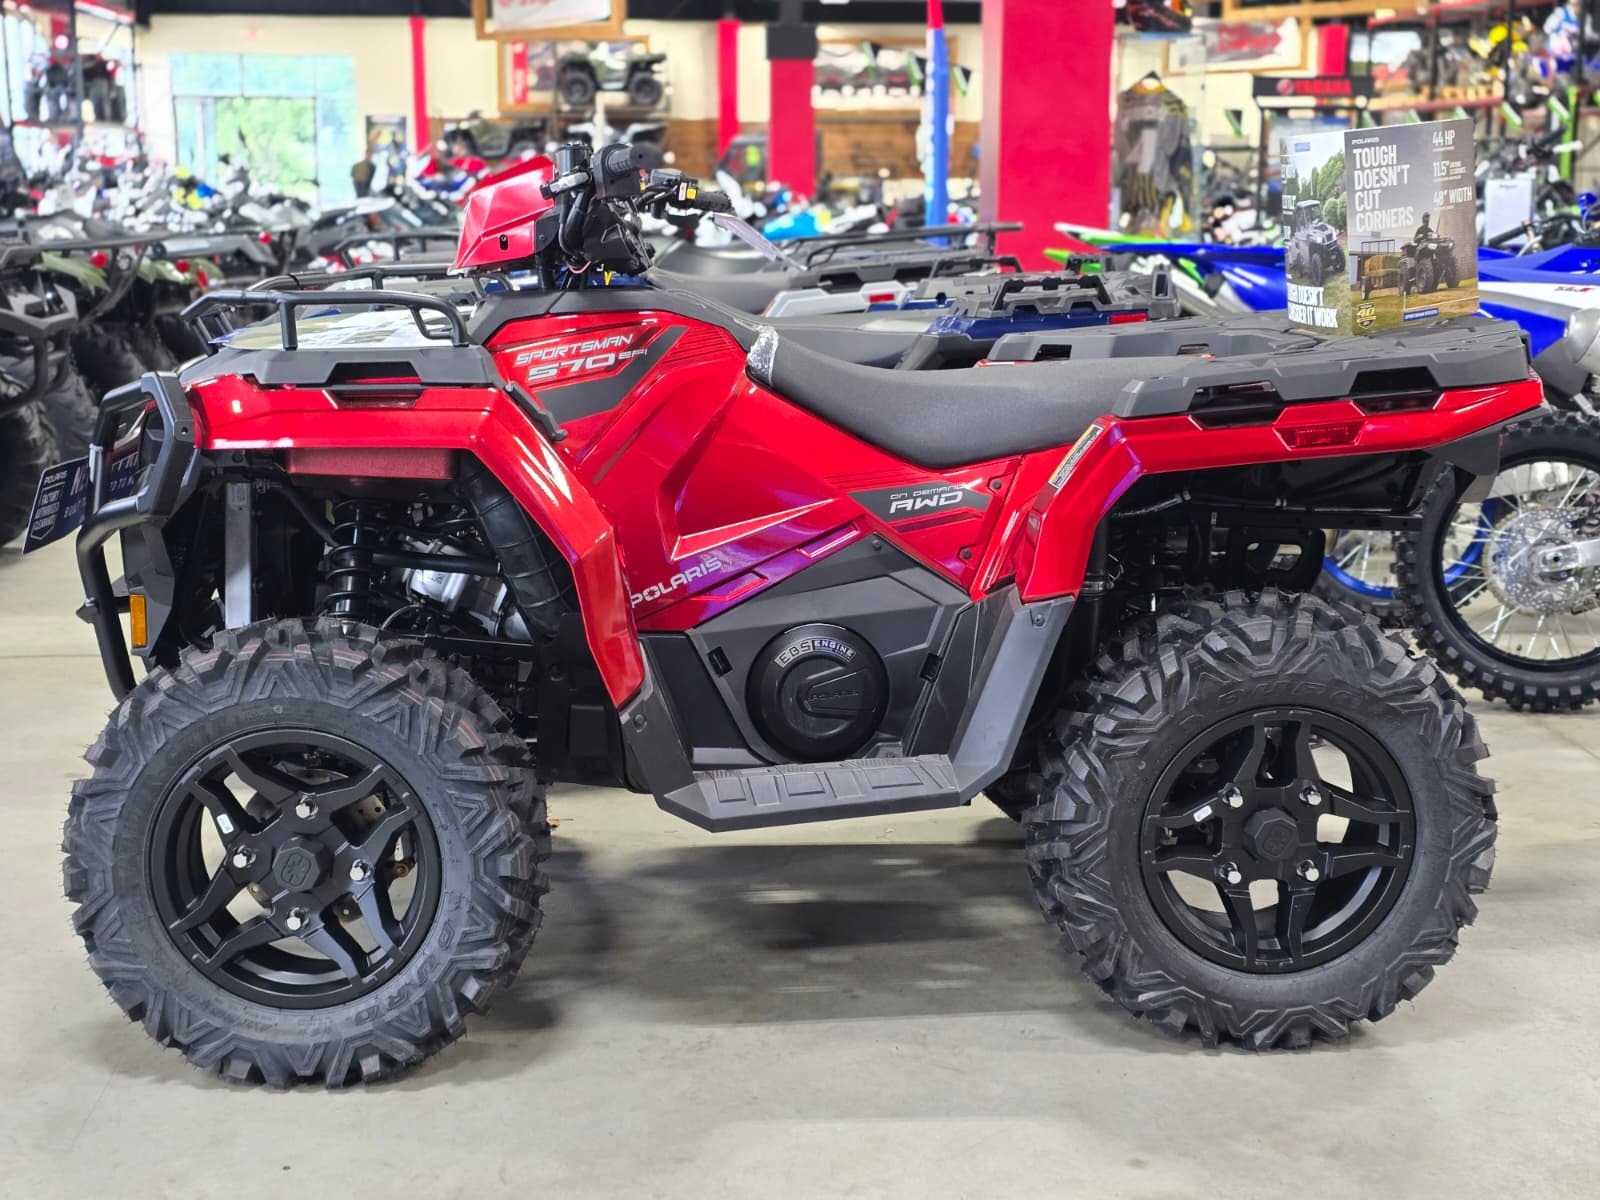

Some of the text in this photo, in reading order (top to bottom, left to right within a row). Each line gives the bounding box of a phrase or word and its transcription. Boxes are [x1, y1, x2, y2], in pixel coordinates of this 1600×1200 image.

[1432, 129, 1455, 147] 44 HP
[1352, 144, 1397, 169] TOUGH
[1354, 163, 1410, 191] DOESN'T
[1355, 189, 1381, 212] CUT
[1449, 186, 1472, 204] WIDTH
[1356, 206, 1414, 233] CORNERS
[1315, 307, 1338, 329] WORK
[514, 333, 634, 366] SPORTSMAN
[527, 348, 648, 381] 570 EFI
[889, 490, 964, 514] AWD
[890, 483, 965, 500] ON DEMAND
[631, 556, 723, 608] POLARIS
[778, 639, 855, 664] EBS ENGINE
